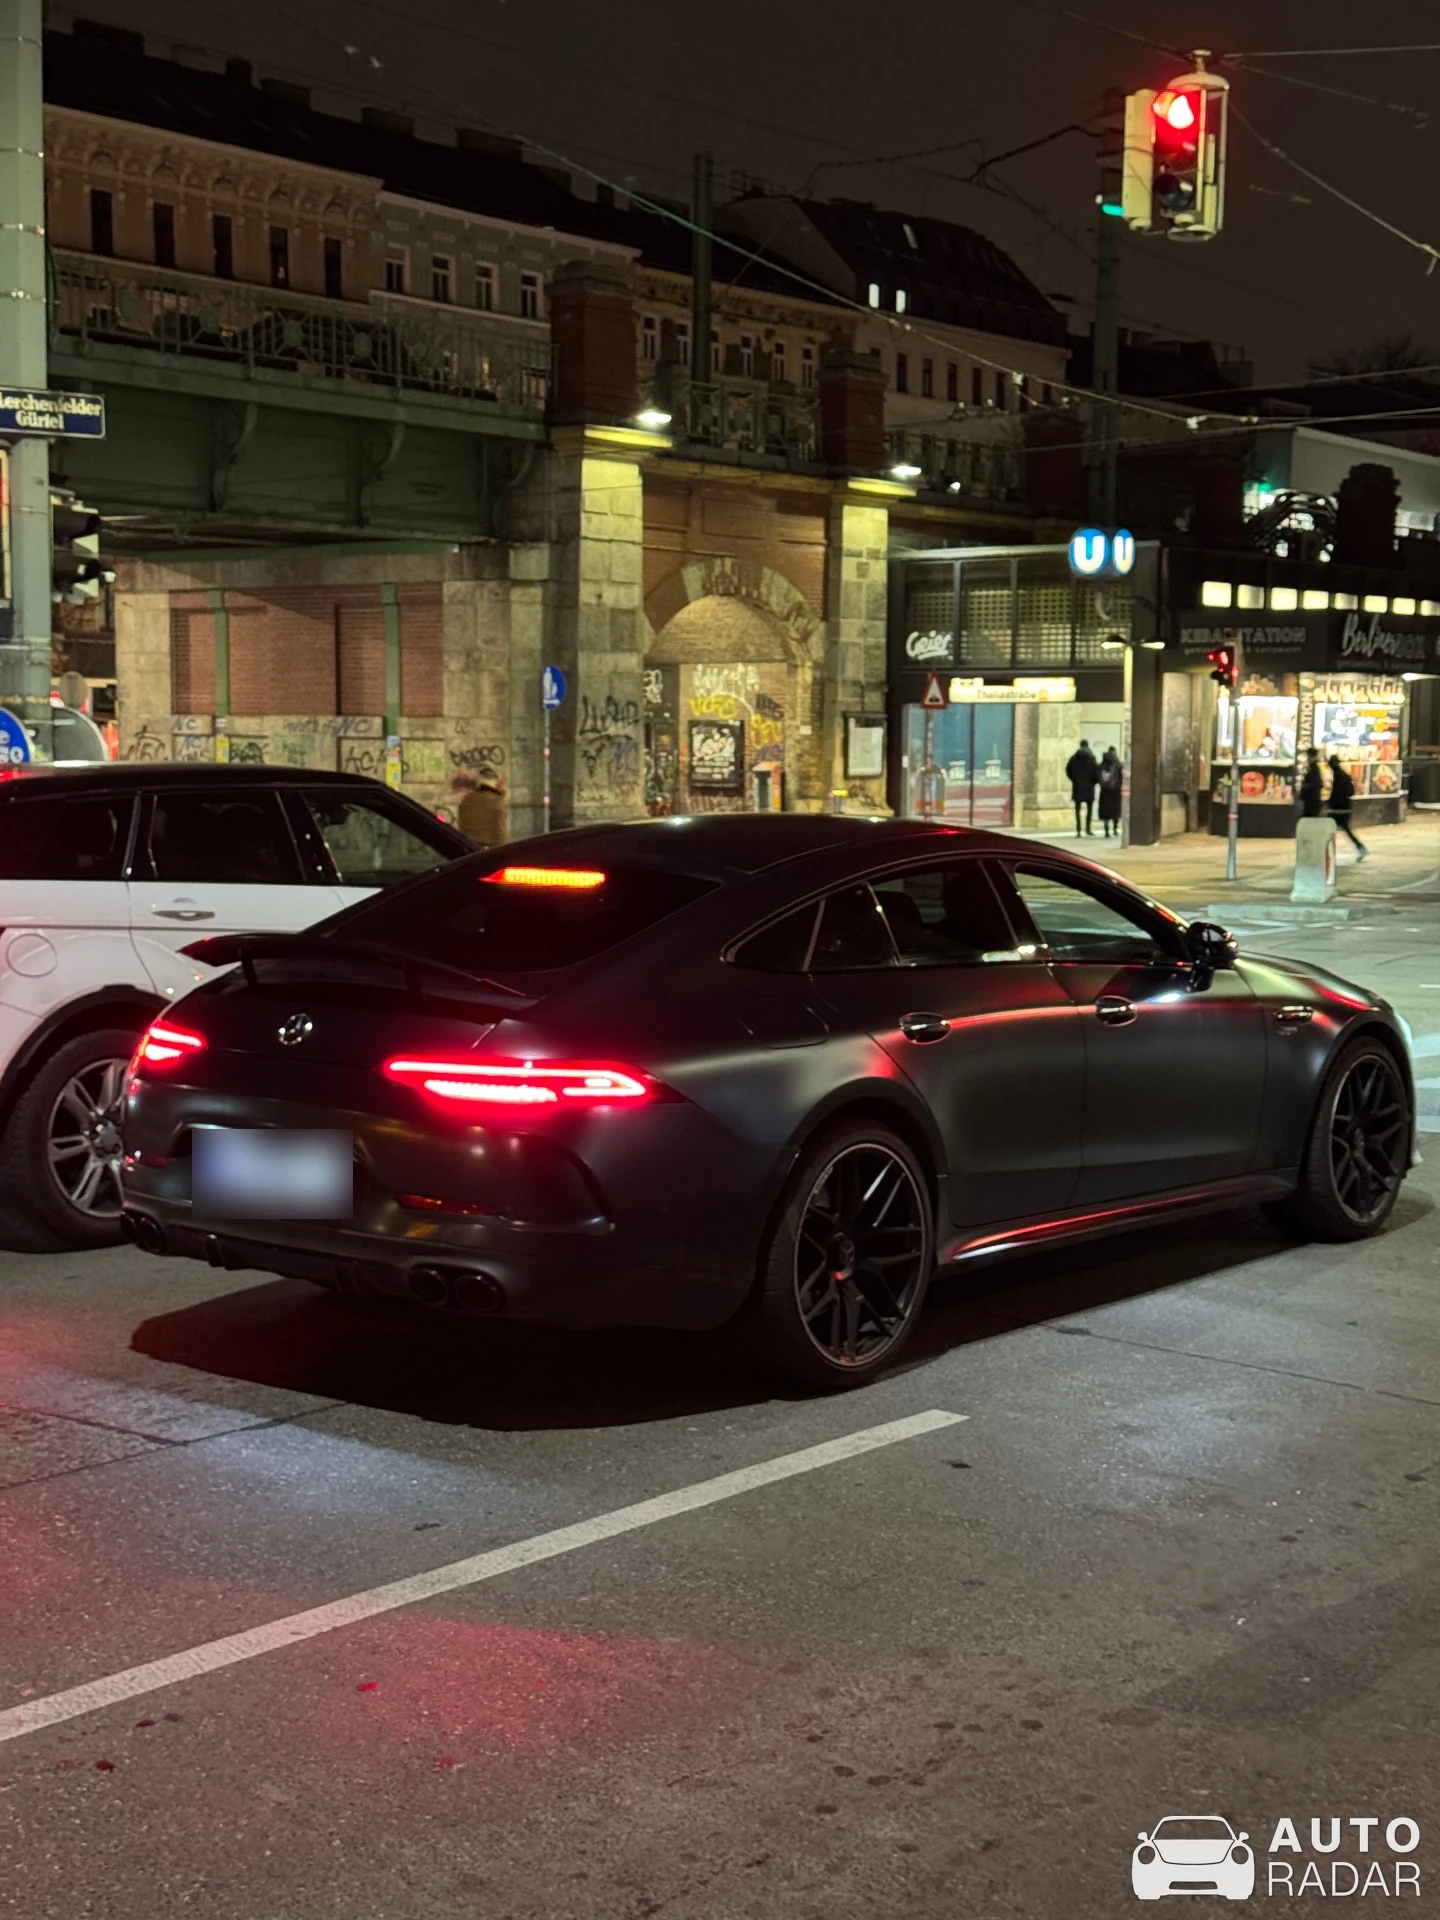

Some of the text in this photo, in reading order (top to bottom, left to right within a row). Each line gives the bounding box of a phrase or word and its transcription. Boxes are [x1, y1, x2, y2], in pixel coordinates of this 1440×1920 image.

[15, 409, 64, 429] Gürtel
[1074, 536, 1105, 572] U
[1114, 535, 1133, 573] U
